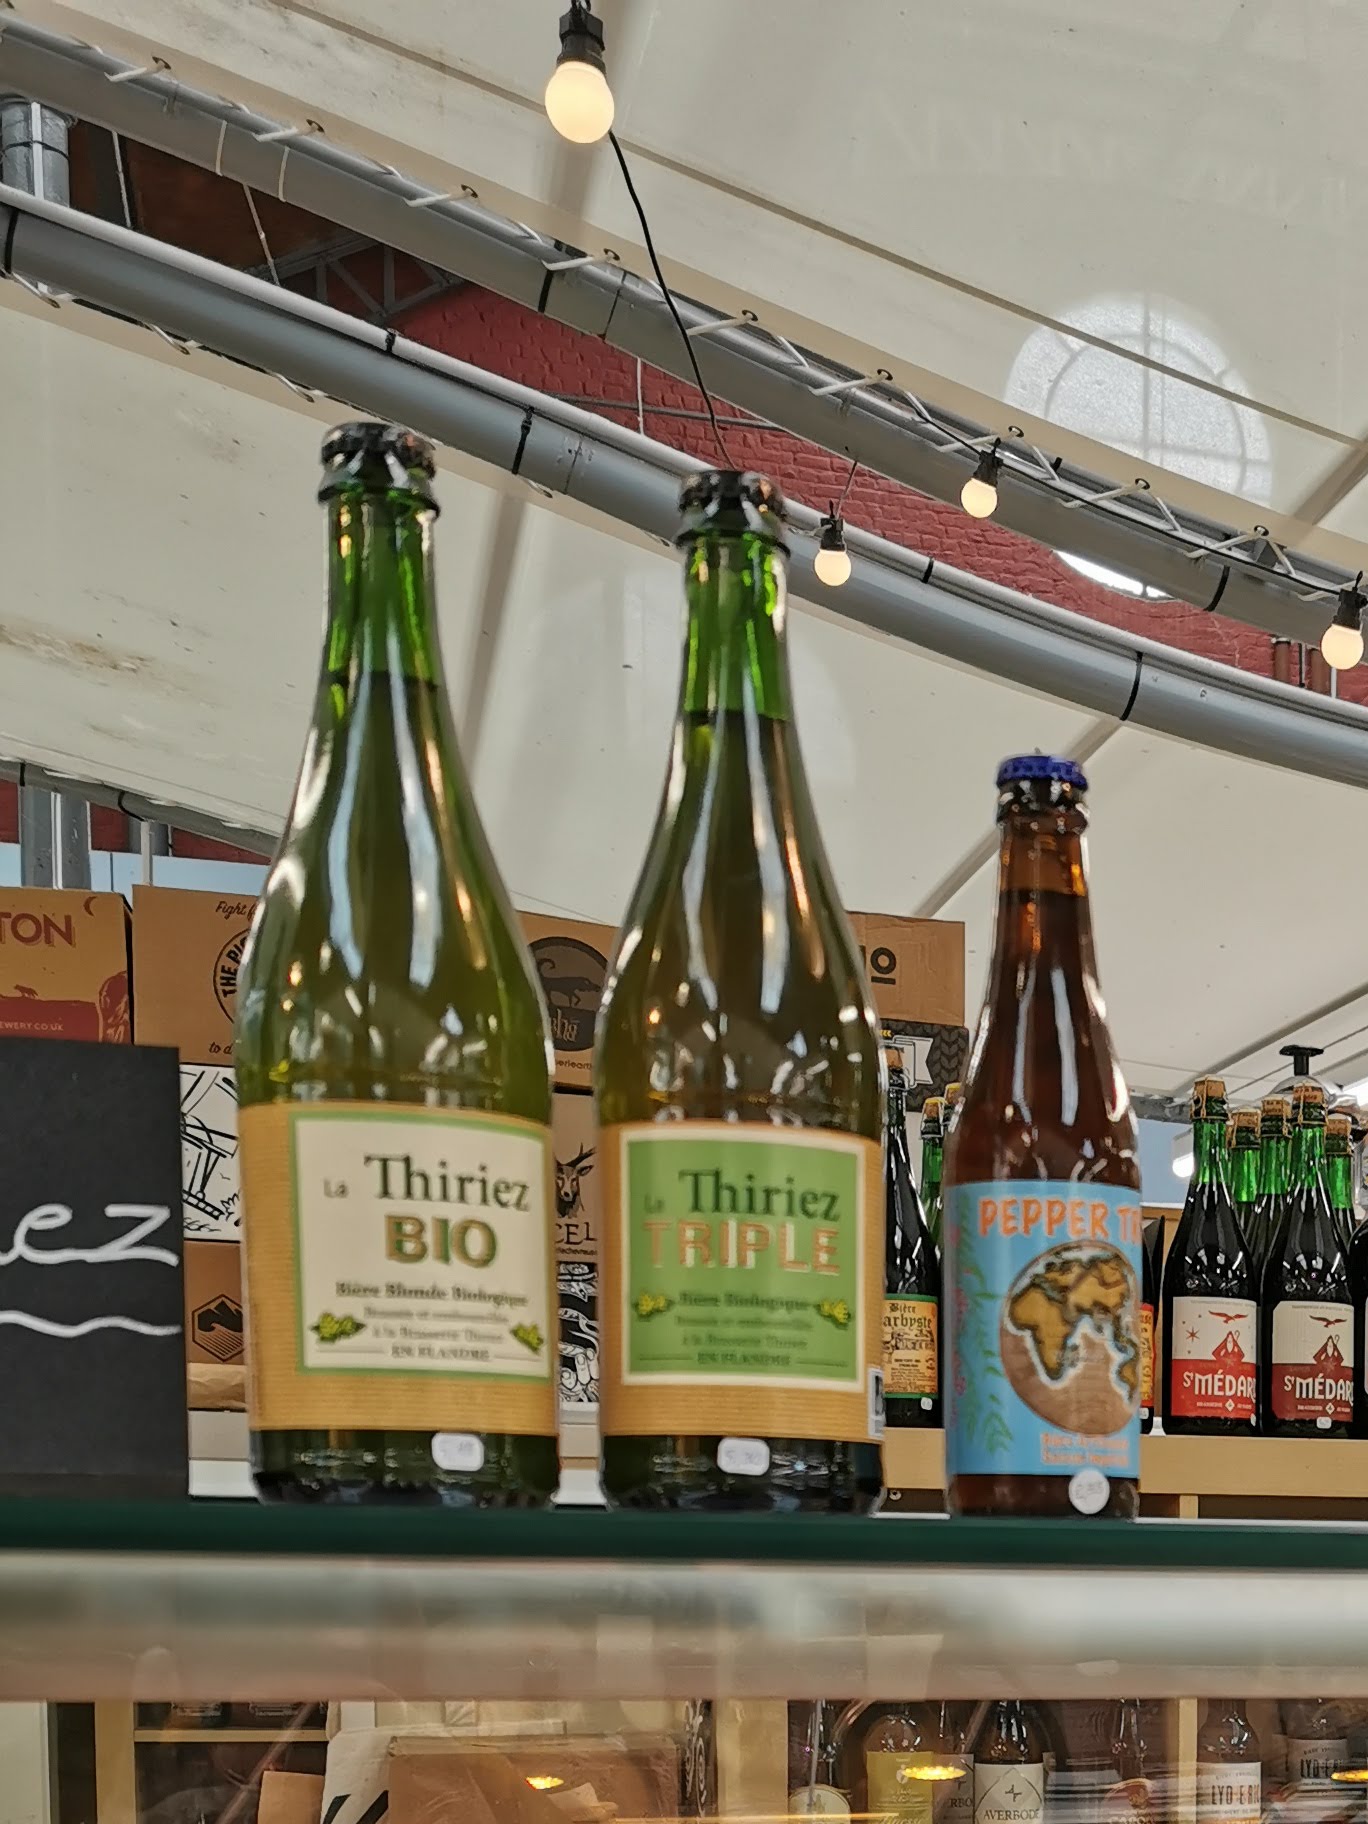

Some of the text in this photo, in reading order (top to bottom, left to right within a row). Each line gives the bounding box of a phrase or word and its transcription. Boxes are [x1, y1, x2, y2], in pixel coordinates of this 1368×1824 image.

[215, 900, 247, 920] Fight
[219, 964, 238, 998] THE
[363, 1152, 530, 1212] Thiriez
[678, 1167, 841, 1222] Thiriez
[978, 1195, 1110, 1239] PEPPER
[384, 1214, 498, 1269] BIO
[643, 1218, 840, 1276] TRIPLE
[1194, 1369, 1257, 1400] MÉDAR
[1295, 1372, 1354, 1406] MÉDAR
[983, 1808, 1040, 1821] AVERBODE
